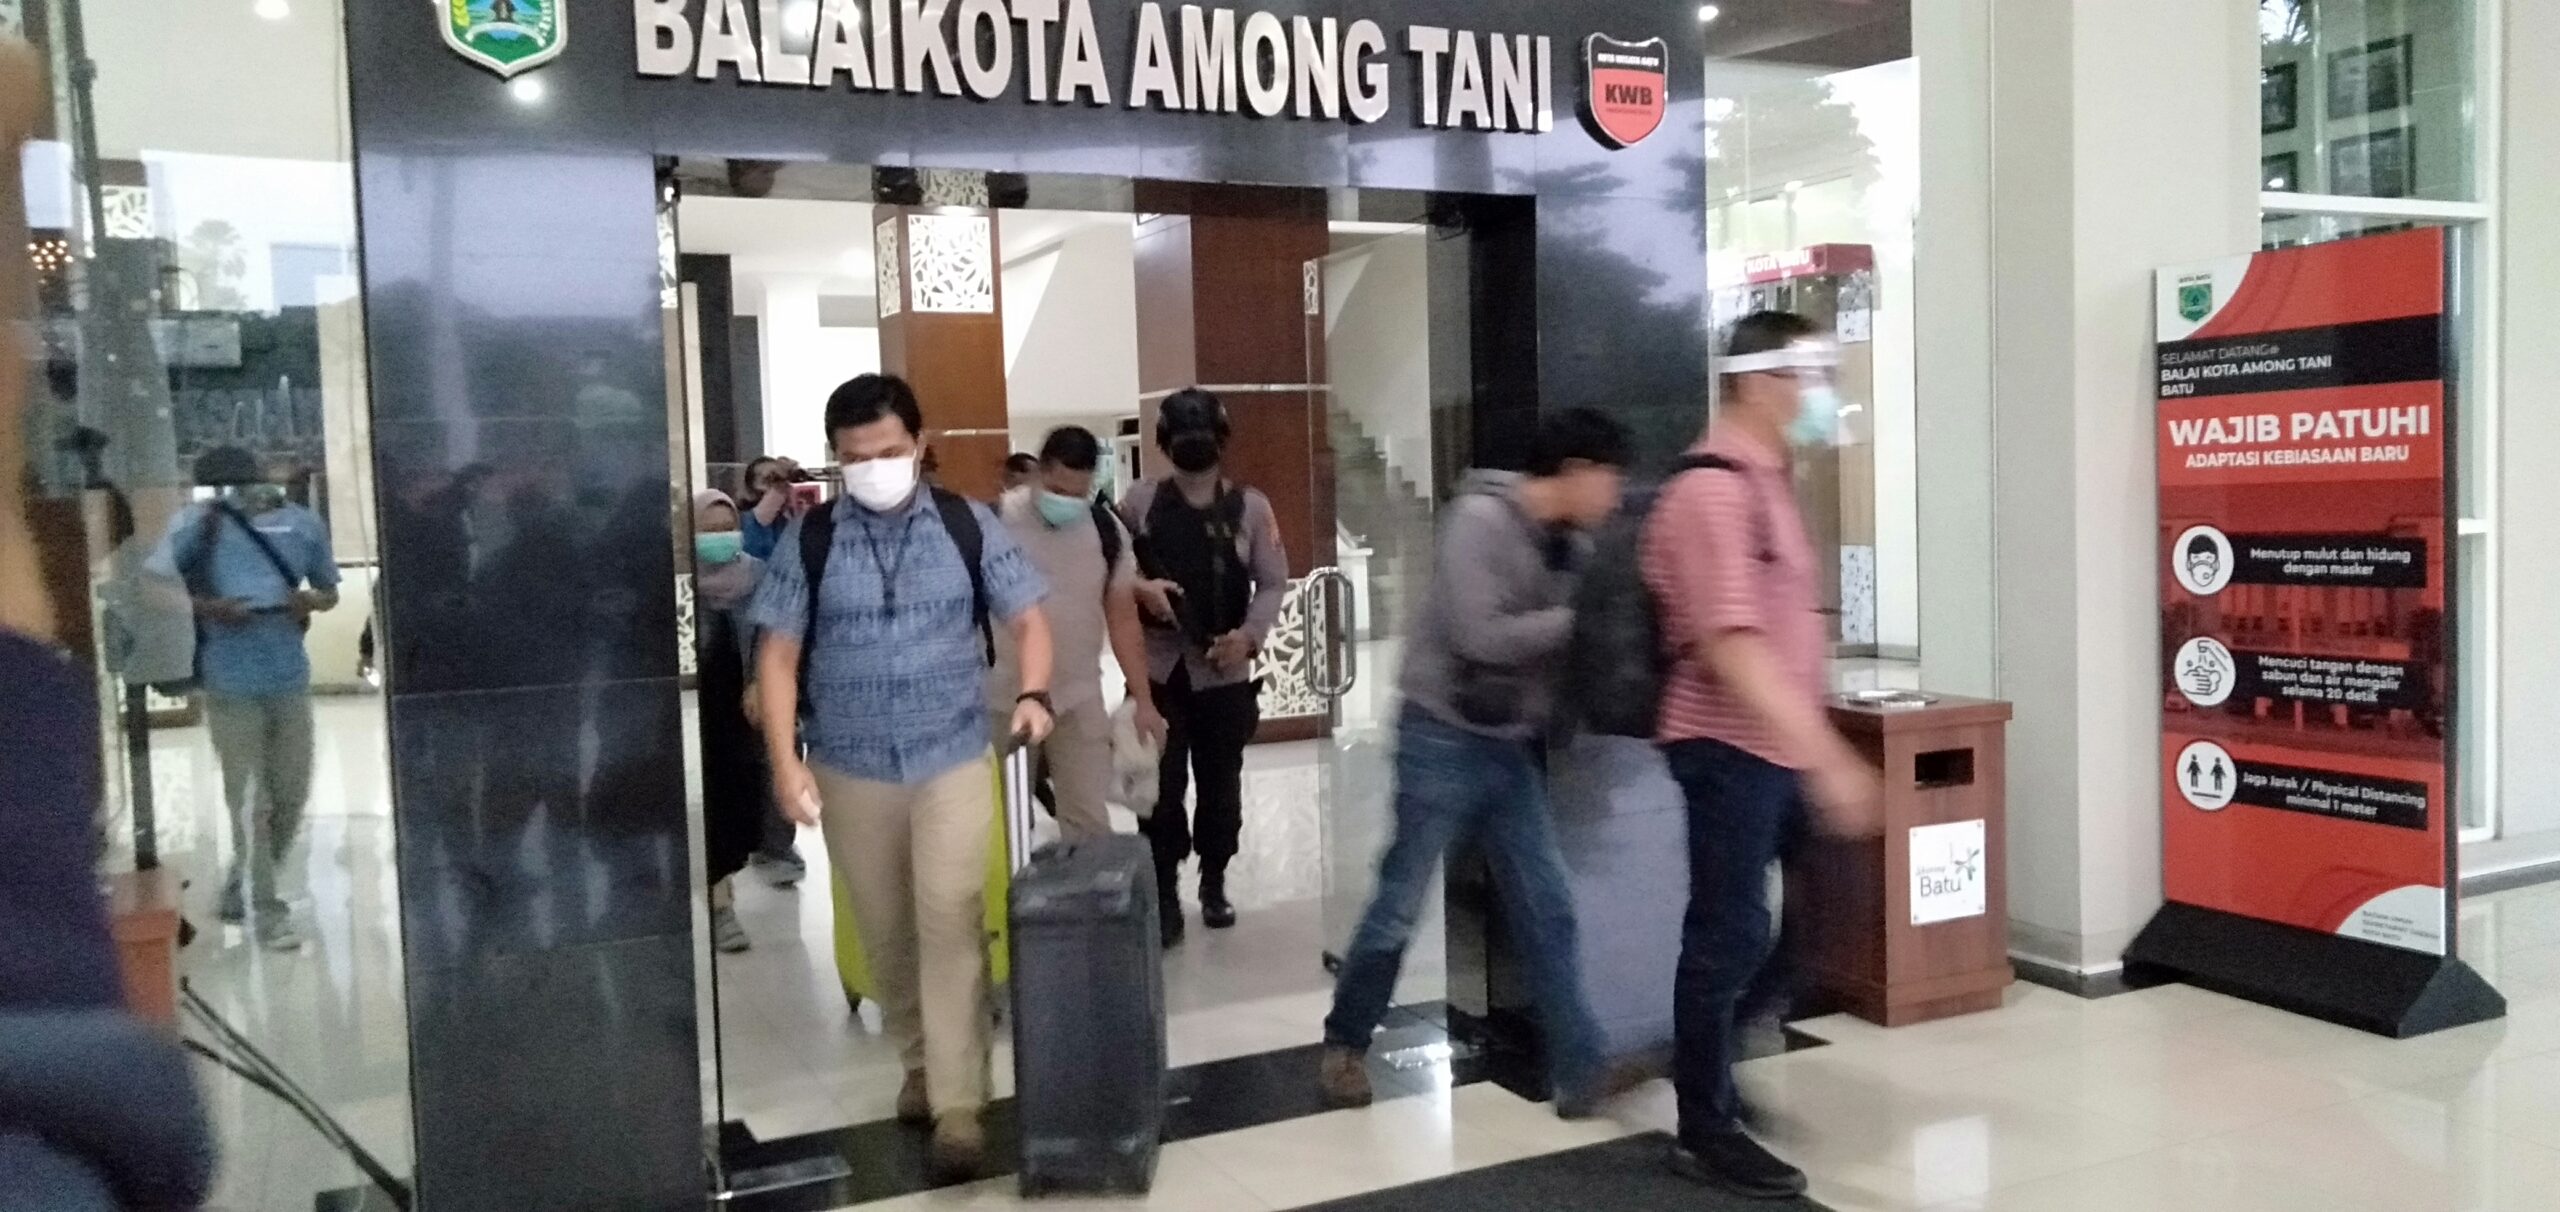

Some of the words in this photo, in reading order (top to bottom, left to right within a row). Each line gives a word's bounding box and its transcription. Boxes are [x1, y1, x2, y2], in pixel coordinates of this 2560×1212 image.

[634, 0, 1111, 104] BALAIKOTA
[1128, 2, 1389, 123] AMONG
[1408, 25, 1553, 133] TANI
[1605, 83, 1653, 106] KWB
[2160, 349, 2216, 365] SELAMAT
[2219, 343, 2271, 360] DATANG
[2160, 368, 2200, 382] BALAI
[2202, 363, 2240, 378] KOTA
[2241, 359, 2296, 375] AMONG
[2299, 354, 2333, 370] TANI
[2160, 383, 2195, 397] BATU
[2168, 412, 2281, 447] WAJIB
[2291, 405, 2431, 440] PATUHI
[2185, 452, 2260, 469] ADAPTASI
[2263, 448, 2357, 466] KEBIASAAN
[2361, 445, 2410, 462] BARU
[2250, 548, 2301, 561] Menutup
[2302, 547, 2338, 560] mulut
[2339, 548, 2364, 560] dan
[2366, 547, 2411, 564] hidung
[2282, 561, 2328, 576] dengan
[2329, 562, 2375, 575] masker
[2257, 655, 2308, 669] Mencuci
[2309, 658, 2353, 675] tangan
[2355, 660, 2405, 677] dengan
[2261, 669, 2298, 681] sabun
[2300, 671, 2323, 684] dan
[2324, 675, 2342, 686] air
[2343, 676, 2401, 690] mengalir
[2281, 685, 2324, 699] selama
[2325, 687, 2343, 700] 20
[2345, 688, 2379, 703] detik
[2300, 778, 2311, 792] /
[2311, 780, 2360, 798] Physical
[2360, 787, 2427, 810] Distancing
[2341, 802, 2378, 816] meter
[1920, 876, 1962, 898] Batu
